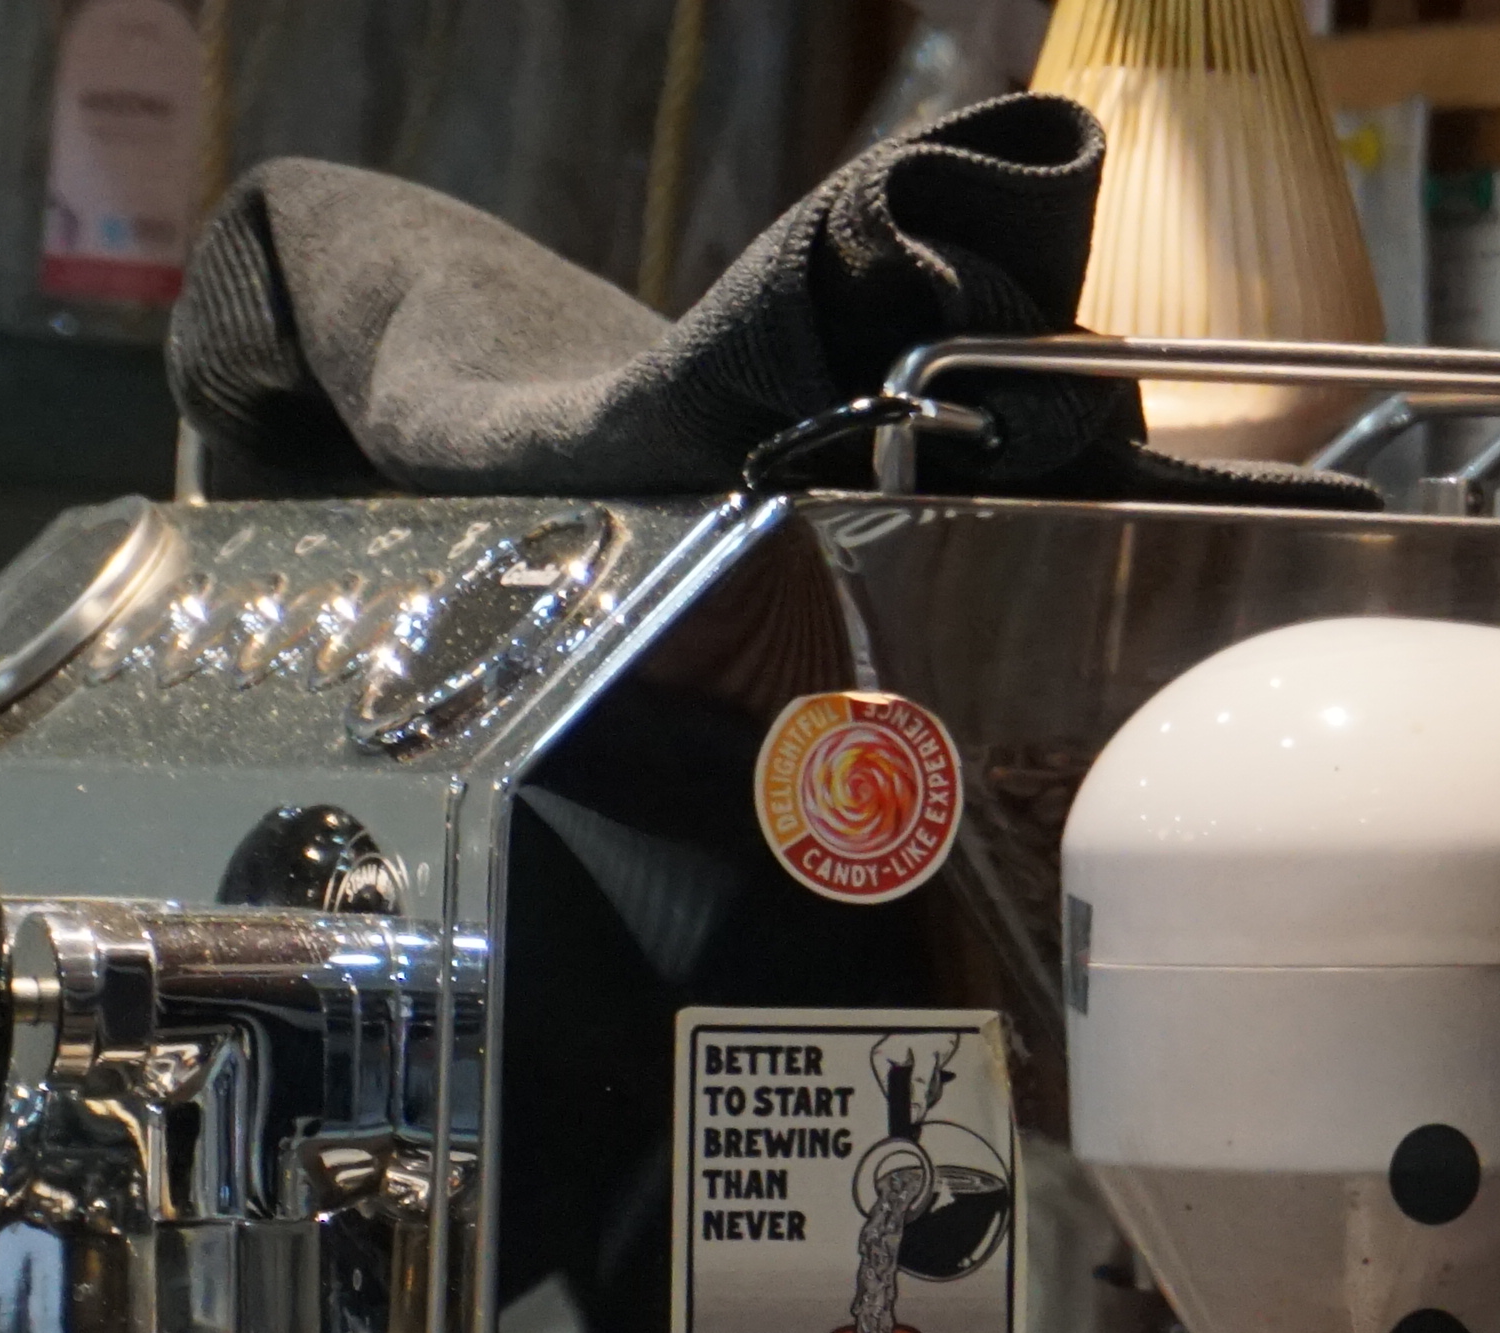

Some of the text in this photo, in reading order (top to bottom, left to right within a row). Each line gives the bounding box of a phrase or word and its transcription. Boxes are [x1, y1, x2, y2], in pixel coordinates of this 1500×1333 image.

[770, 702, 841, 834] DELIGHTFUL
[802, 700, 951, 888] CANDY-LIKE EXPERIENCE
[705, 1044, 824, 1076] BETTER
[703, 1086, 855, 1118] TO START
[704, 1127, 853, 1160] BREWING
[702, 1168, 788, 1200] THAN
[702, 1210, 806, 1241] NEVER
